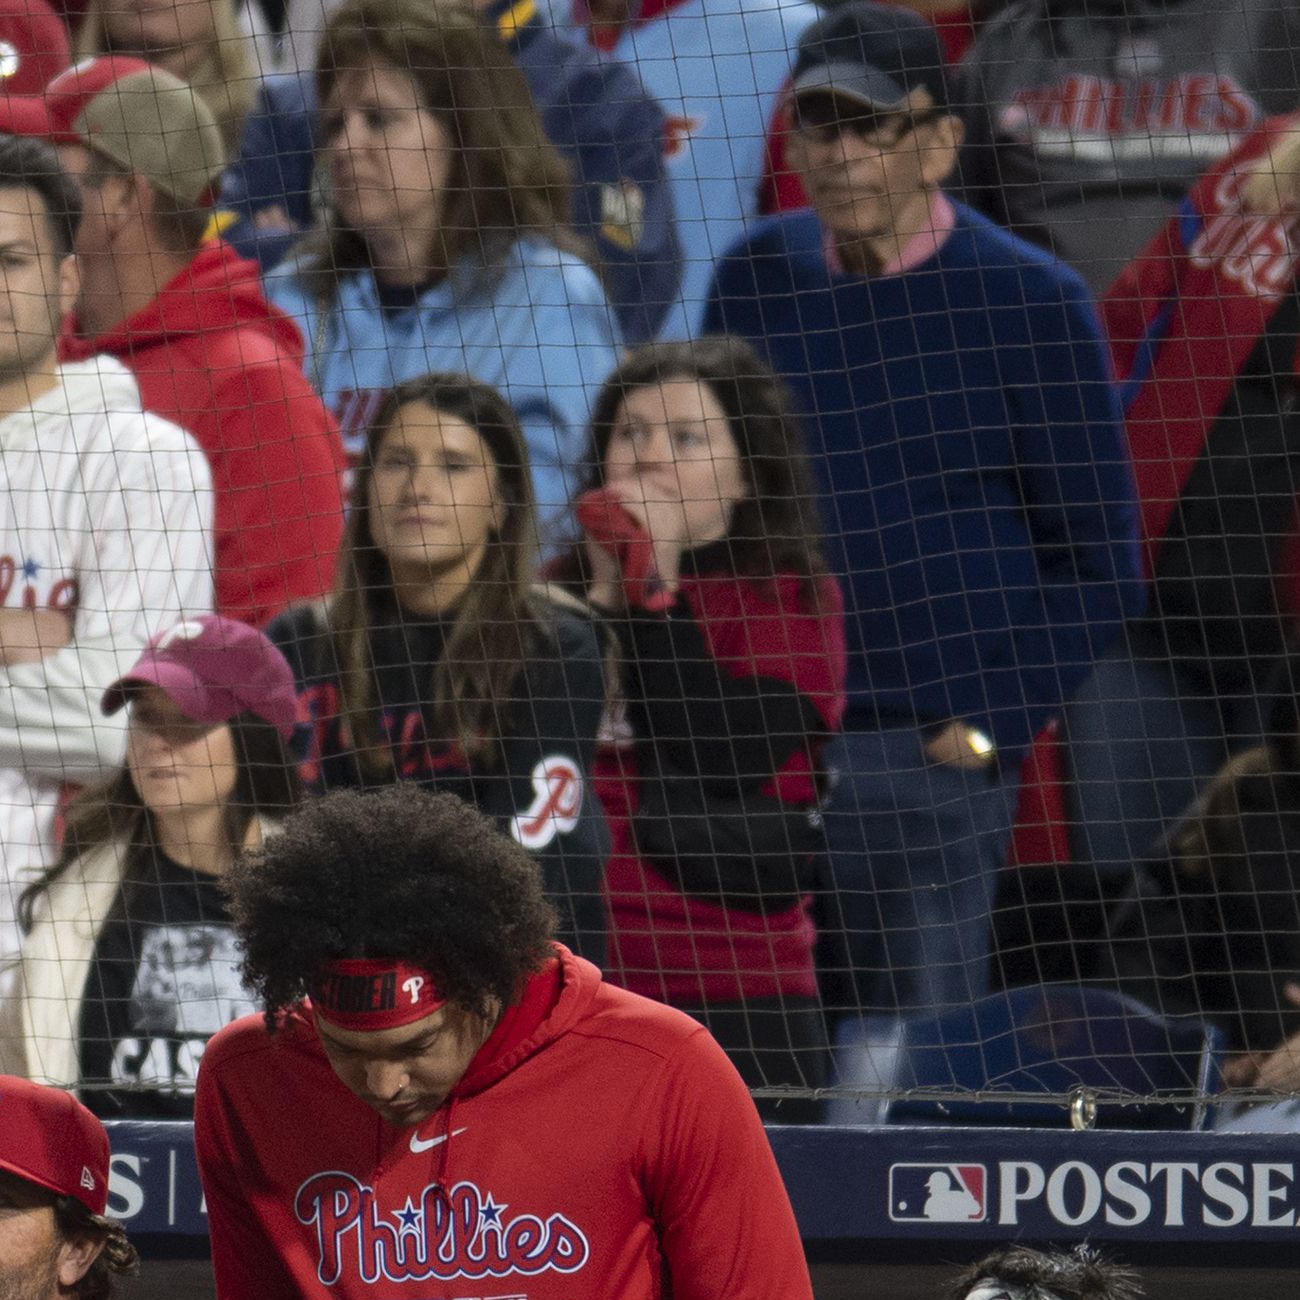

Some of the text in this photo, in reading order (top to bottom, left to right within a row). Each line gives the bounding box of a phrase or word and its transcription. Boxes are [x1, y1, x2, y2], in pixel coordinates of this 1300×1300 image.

[510, 756, 584, 849] P
[401, 976, 424, 1004] P
[294, 1170, 590, 1286] Phillies
[998, 1160, 1296, 1227] POSTSE
